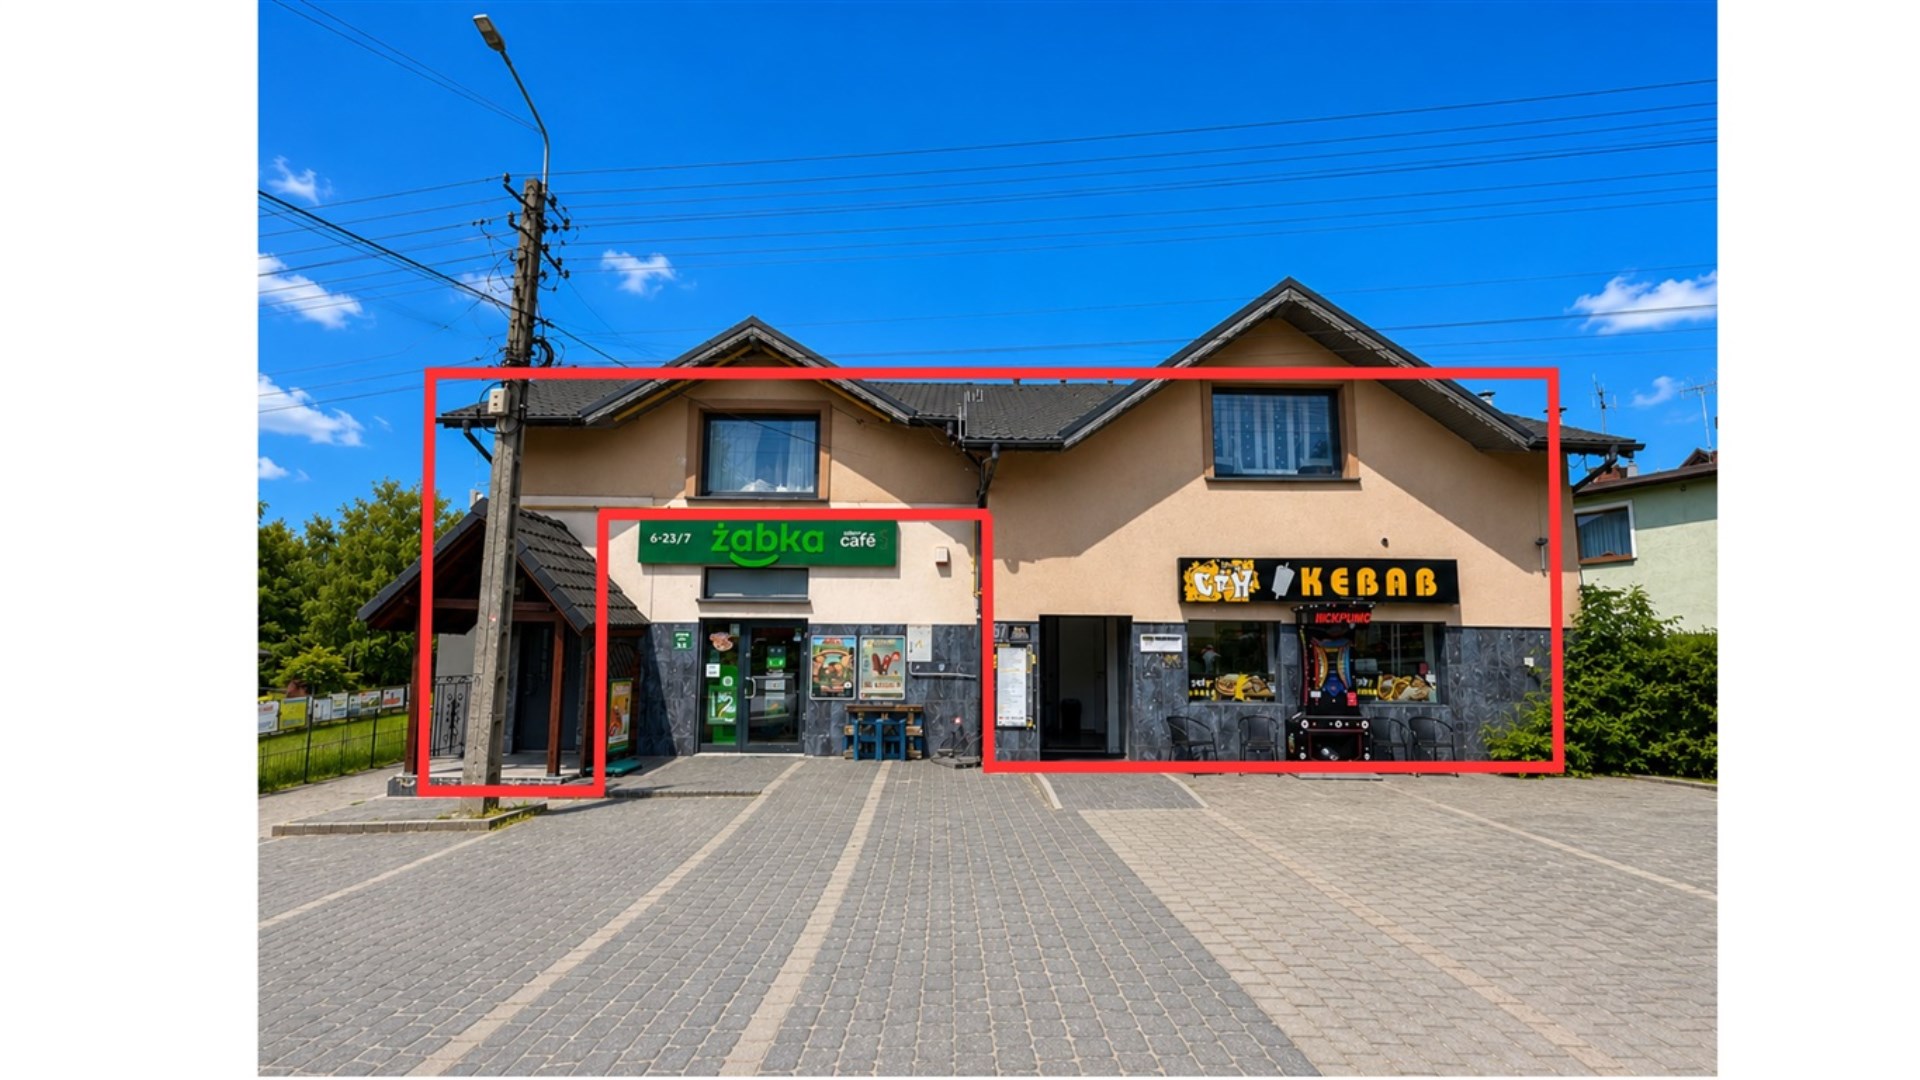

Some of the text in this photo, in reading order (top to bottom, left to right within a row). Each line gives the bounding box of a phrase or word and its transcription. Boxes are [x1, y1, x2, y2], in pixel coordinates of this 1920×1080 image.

[650, 533, 691, 545] 6-23/7
[711, 522, 824, 553] żabka
[840, 531, 876, 547] café
[1301, 567, 1437, 597] KEBAB
